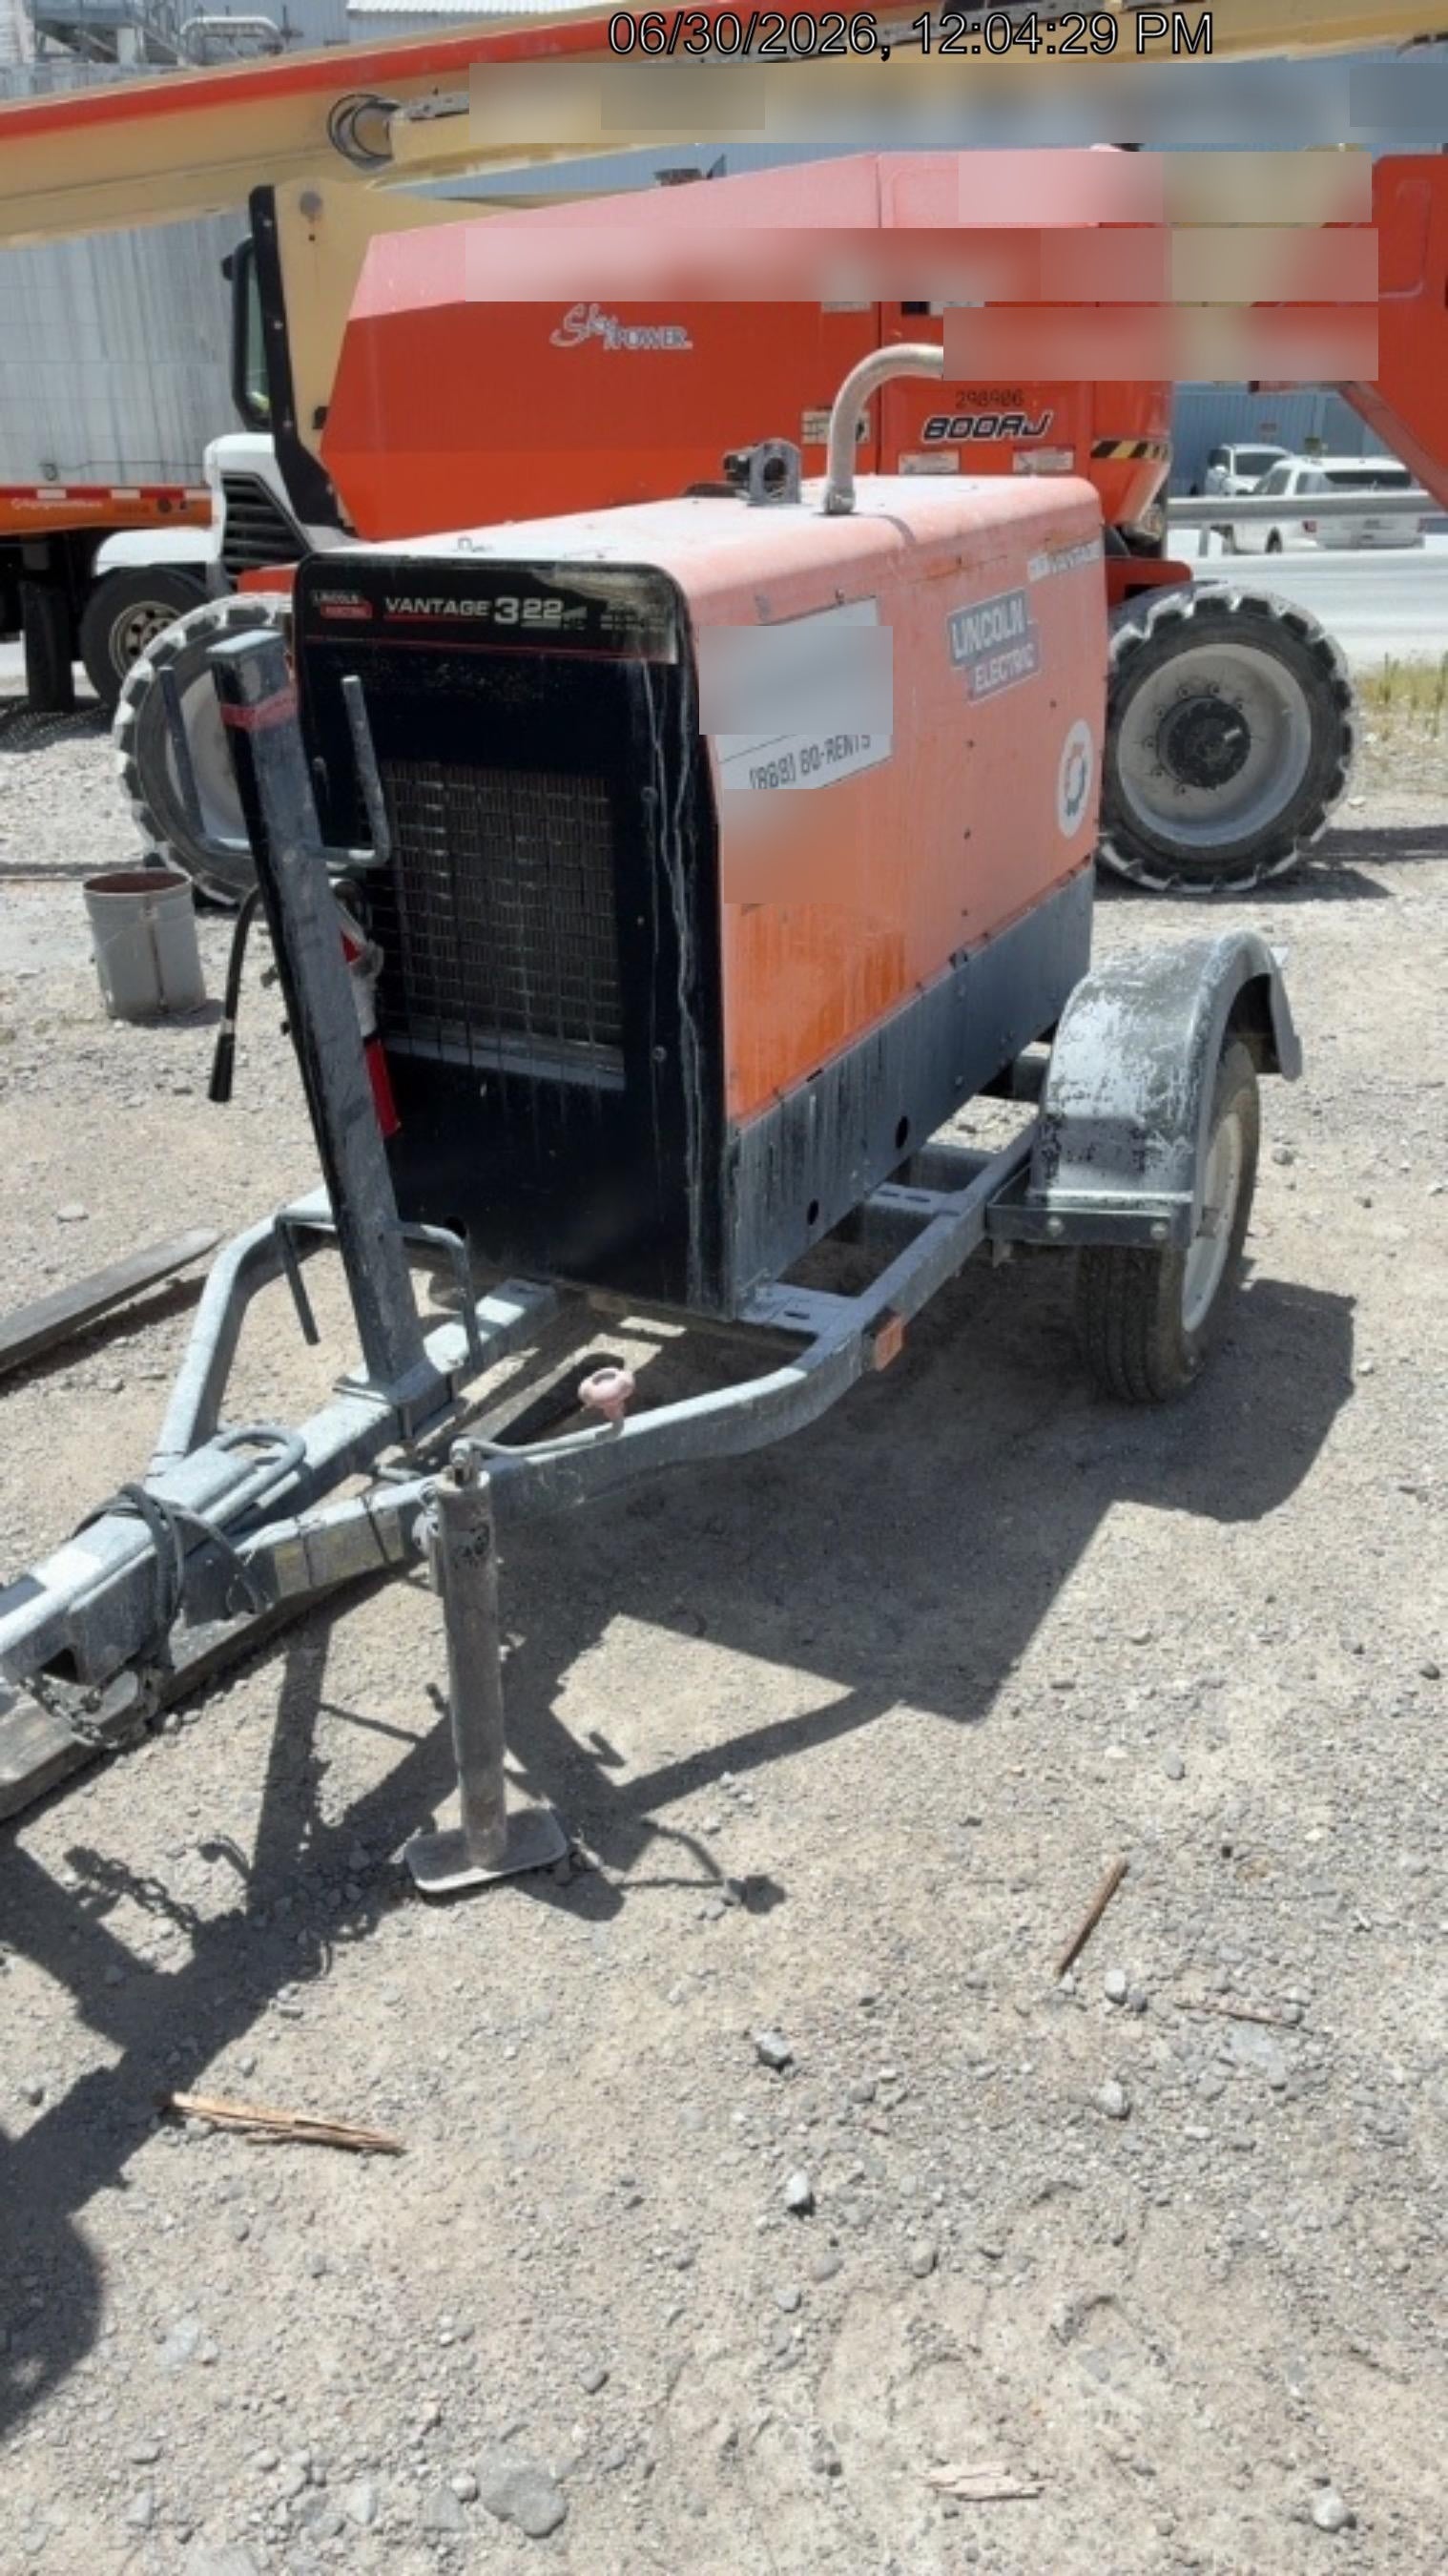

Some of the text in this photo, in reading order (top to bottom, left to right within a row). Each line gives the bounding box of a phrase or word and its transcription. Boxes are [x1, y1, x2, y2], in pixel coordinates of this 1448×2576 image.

[922, 410, 1052, 443] 800AJ
[385, 597, 490, 616] VANTAGE
[494, 597, 563, 625] 322
[952, 597, 1025, 658] LINCOLN
[975, 642, 1034, 694] ELECTRIC
